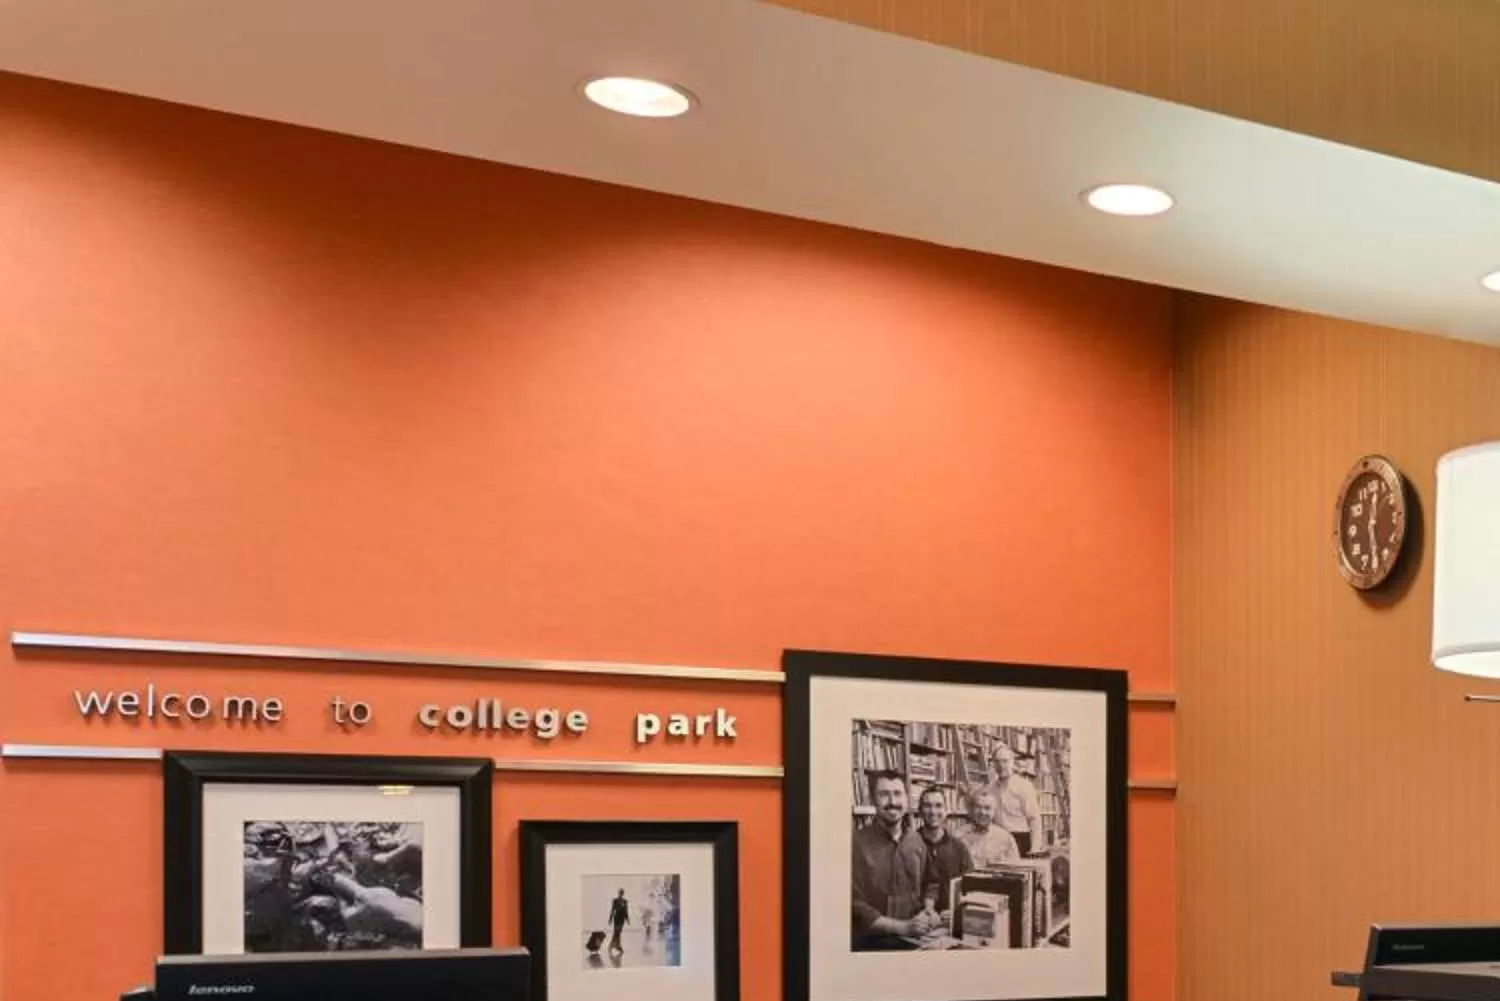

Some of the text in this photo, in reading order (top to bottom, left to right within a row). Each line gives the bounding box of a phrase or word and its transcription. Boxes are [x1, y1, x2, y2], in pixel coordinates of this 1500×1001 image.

[74, 684, 737, 743] welcome to college park
[188, 984, 255, 996] lenovo
